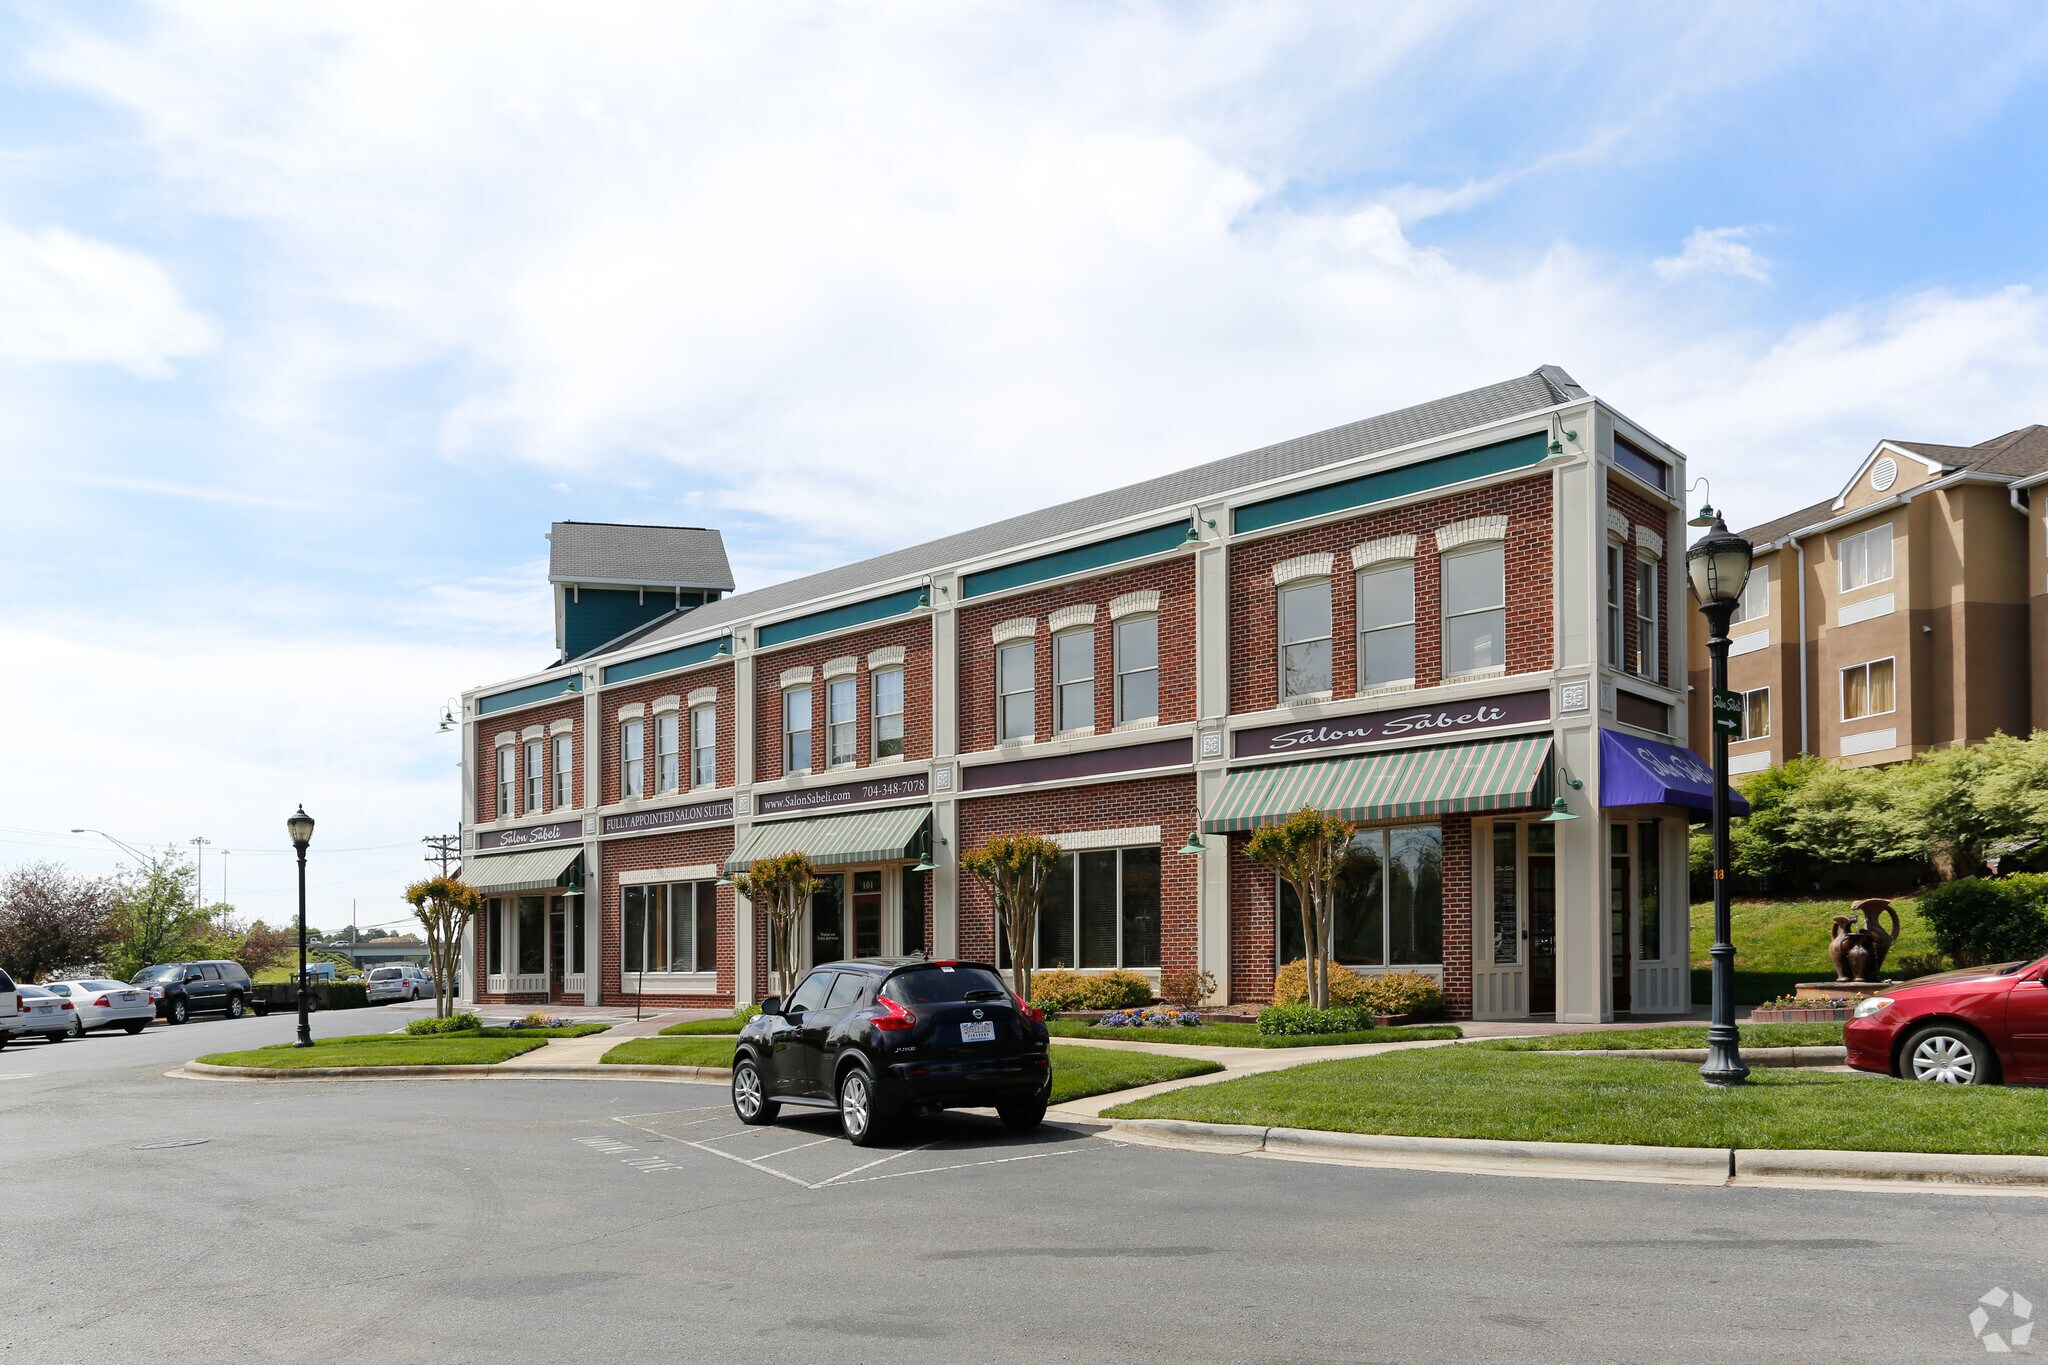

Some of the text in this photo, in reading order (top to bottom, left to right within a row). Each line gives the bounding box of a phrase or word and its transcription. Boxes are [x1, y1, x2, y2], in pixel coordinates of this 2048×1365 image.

[1269, 706, 1507, 749] Salon Sabeli
[764, 779, 925, 809] www.SalonSabeli.com 704-348-7078
[606, 802, 733, 830] FULLY APPOINTED SALON SUITES
[500, 825, 561, 846] Salon Sabeli
[862, 880, 874, 889] 101
